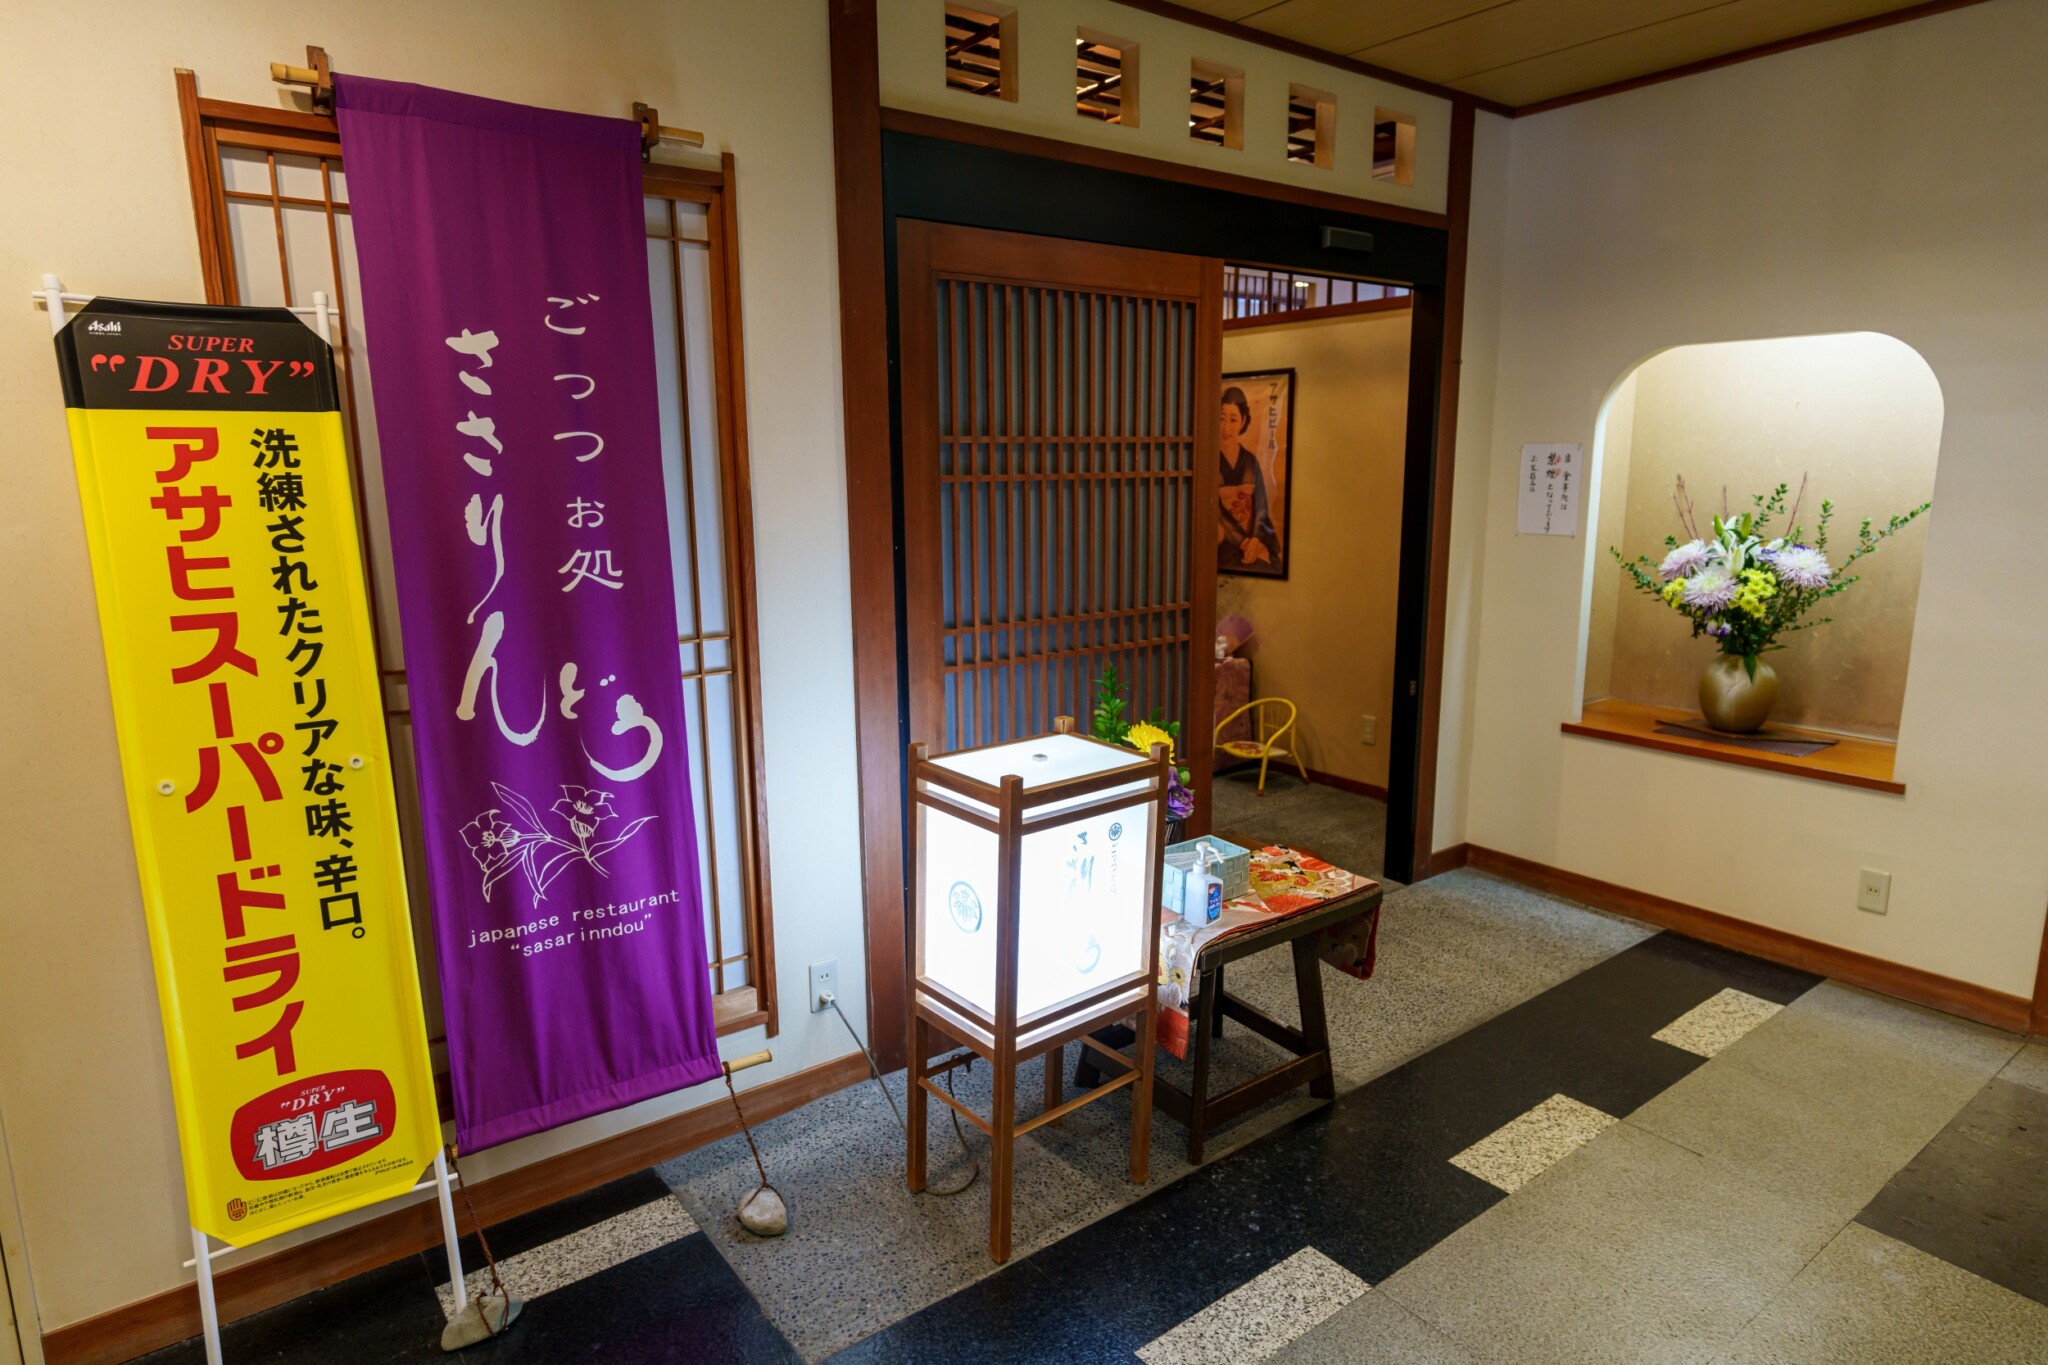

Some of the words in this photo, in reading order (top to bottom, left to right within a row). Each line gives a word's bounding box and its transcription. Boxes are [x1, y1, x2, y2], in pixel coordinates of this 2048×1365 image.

[88, 320, 122, 333] Asahi
[167, 333, 255, 354] SUPER
[250, 427, 366, 940] 洗練されたクリアな味、辛口。
[145, 426, 305, 1077] アサヒスーパードライ
[468, 914, 560, 948] japanese
[572, 889, 680, 922] restaurant
[301, 1084, 327, 1096] SUPER
[252, 1099, 383, 1171] 樽生
